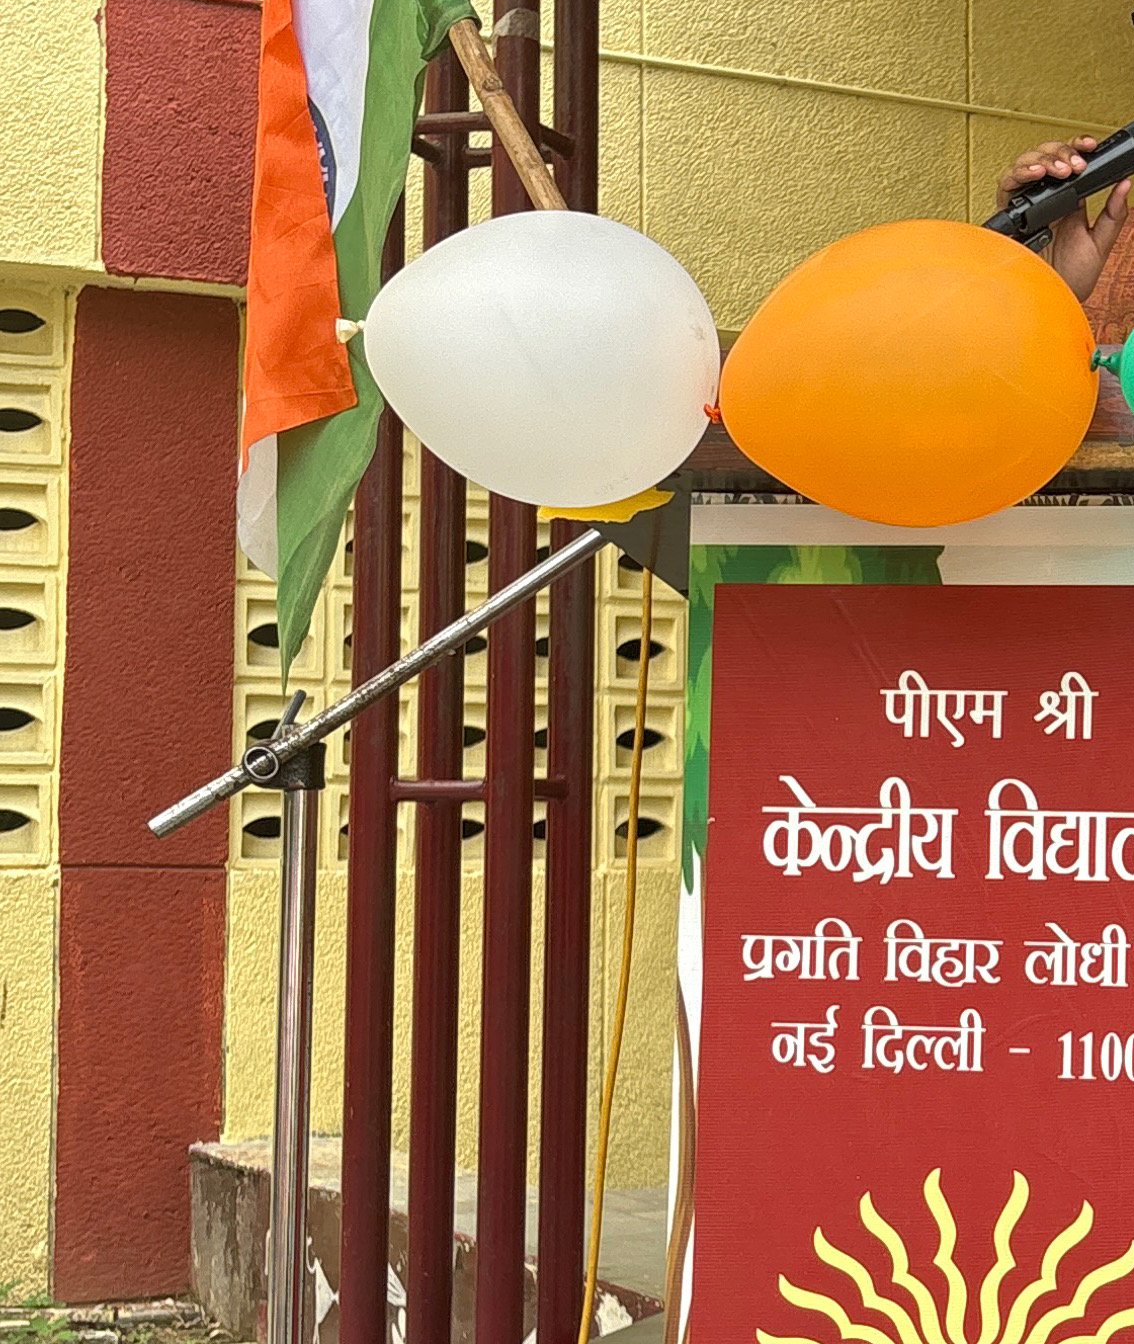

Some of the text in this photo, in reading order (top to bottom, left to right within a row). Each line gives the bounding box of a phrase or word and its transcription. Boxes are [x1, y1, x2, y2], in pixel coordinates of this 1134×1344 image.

[879, 670, 1099, 748] पीएम श्री
[761, 775, 959, 885] केन्द्रीय
[740, 917, 863, 981] प्रगति
[883, 919, 1004, 988] विहार
[1023, 922, 1132, 988] लोधी
[771, 1004, 840, 1074] नई
[861, 1005, 987, 1074] दिल्ली
